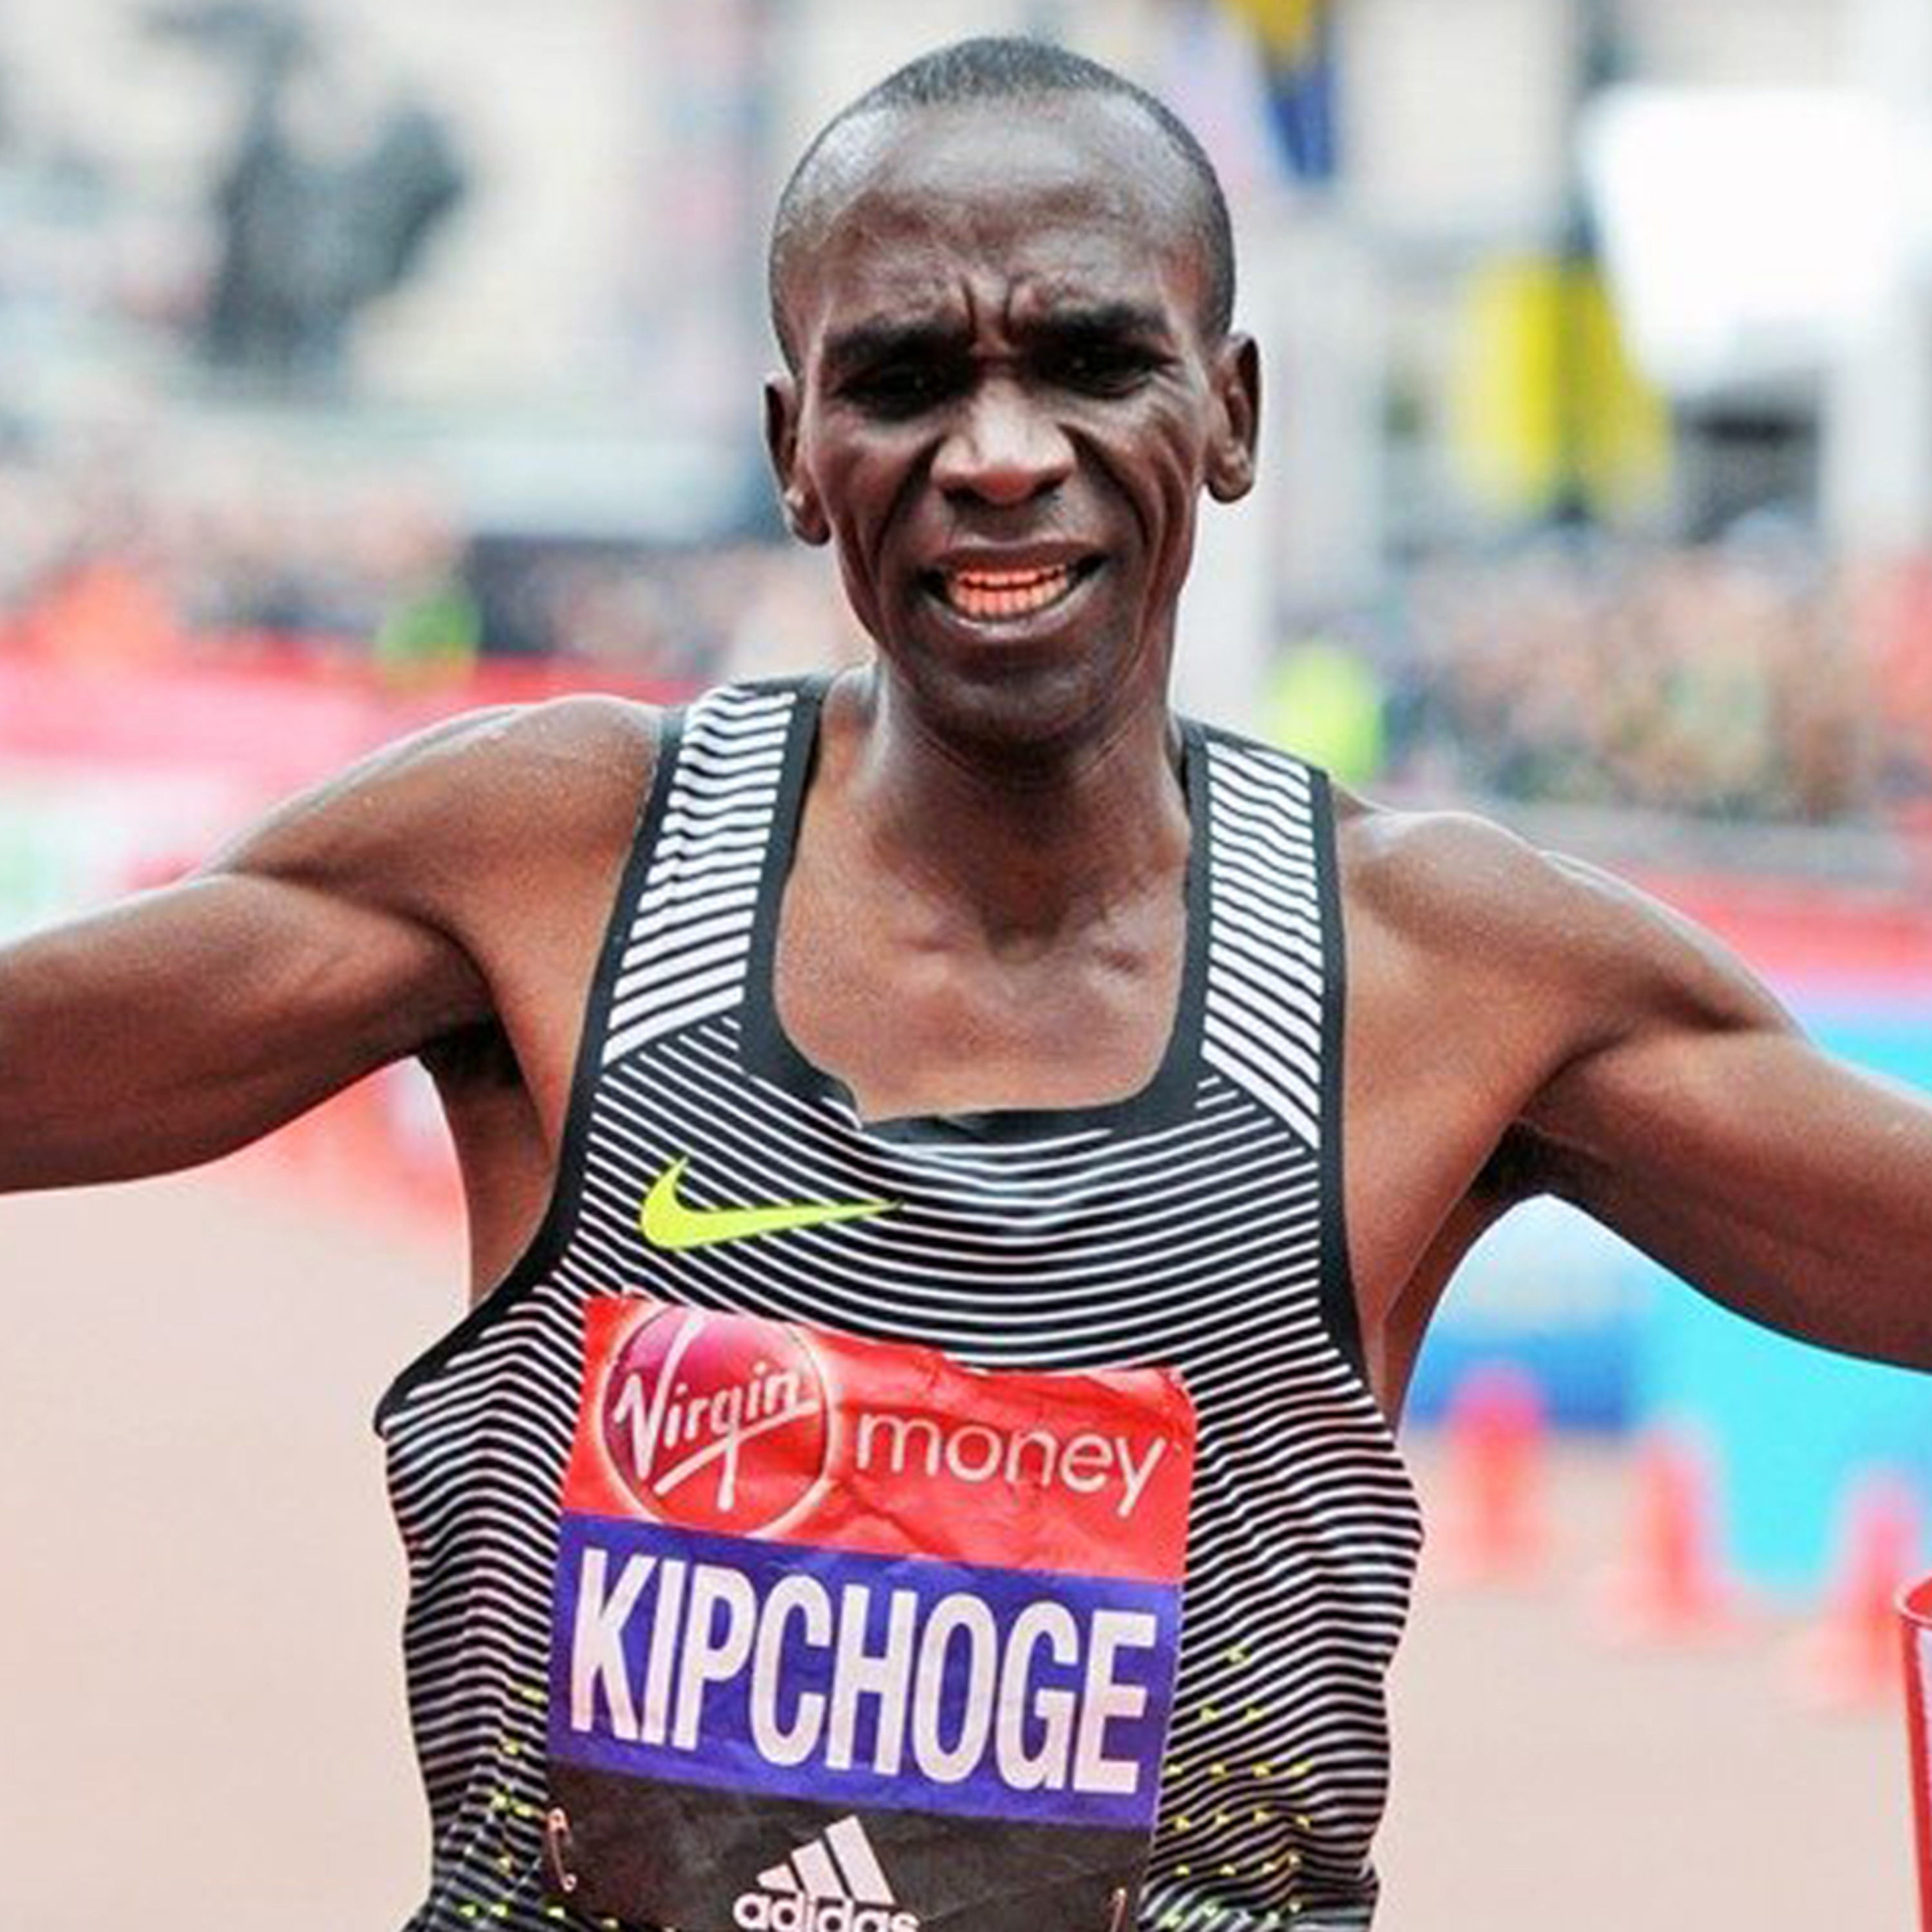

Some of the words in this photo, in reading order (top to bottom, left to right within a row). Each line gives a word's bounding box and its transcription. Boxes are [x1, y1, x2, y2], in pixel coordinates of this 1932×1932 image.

[612, 1316, 819, 1511] Virgin
[856, 1412, 1166, 1517] money
[570, 1548, 1157, 1795] KIPCHOGE
